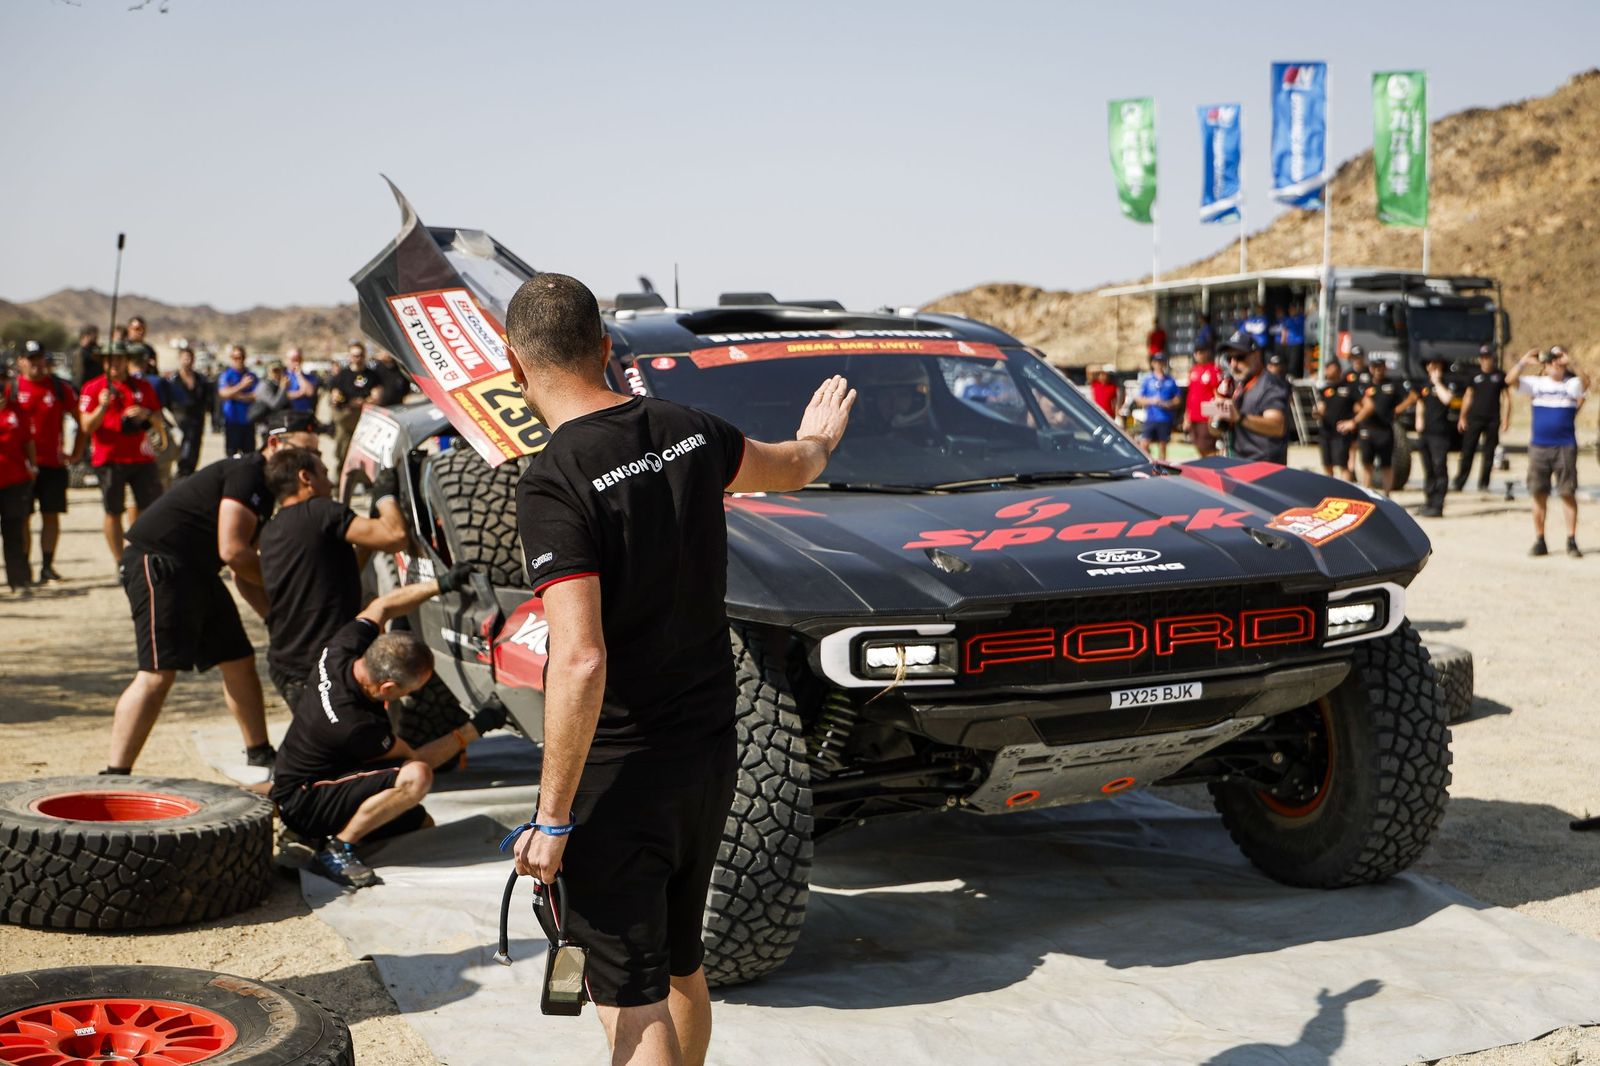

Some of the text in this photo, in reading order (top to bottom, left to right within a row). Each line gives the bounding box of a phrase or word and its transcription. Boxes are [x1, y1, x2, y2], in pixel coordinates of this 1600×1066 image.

[411, 319, 448, 371] TUDOR
[426, 306, 484, 370] MOTUL
[787, 341, 924, 353] DREAM. DARE. LIVE IT.
[592, 458, 649, 492] BENSON
[902, 508, 1254, 551] spark
[1086, 561, 1186, 577] RACING
[1095, 549, 1146, 564] Ford
[965, 606, 1315, 673] FORD
[1119, 684, 1194, 707] PX25 BJK
